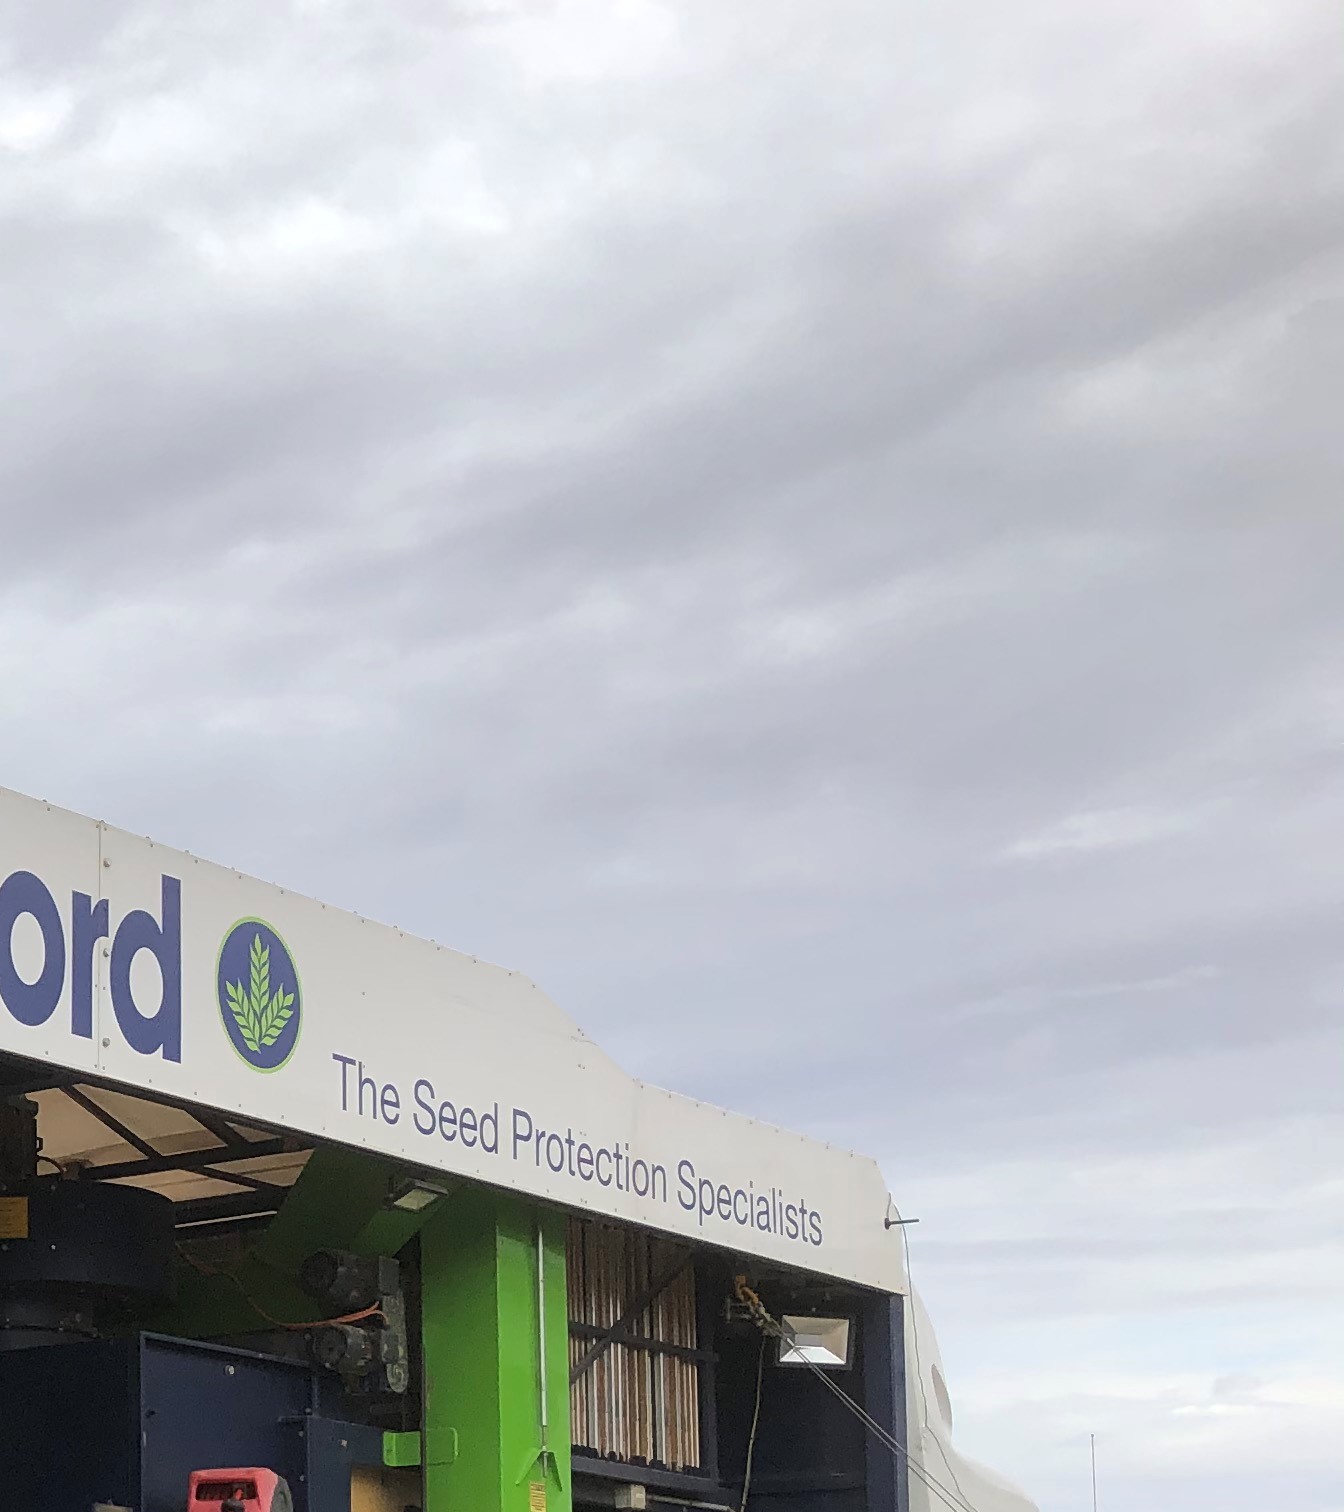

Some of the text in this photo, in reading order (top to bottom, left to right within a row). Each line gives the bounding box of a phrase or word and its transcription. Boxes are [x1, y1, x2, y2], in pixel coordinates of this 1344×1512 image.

[332, 1052, 824, 1247] The Seed Protection Specialists
